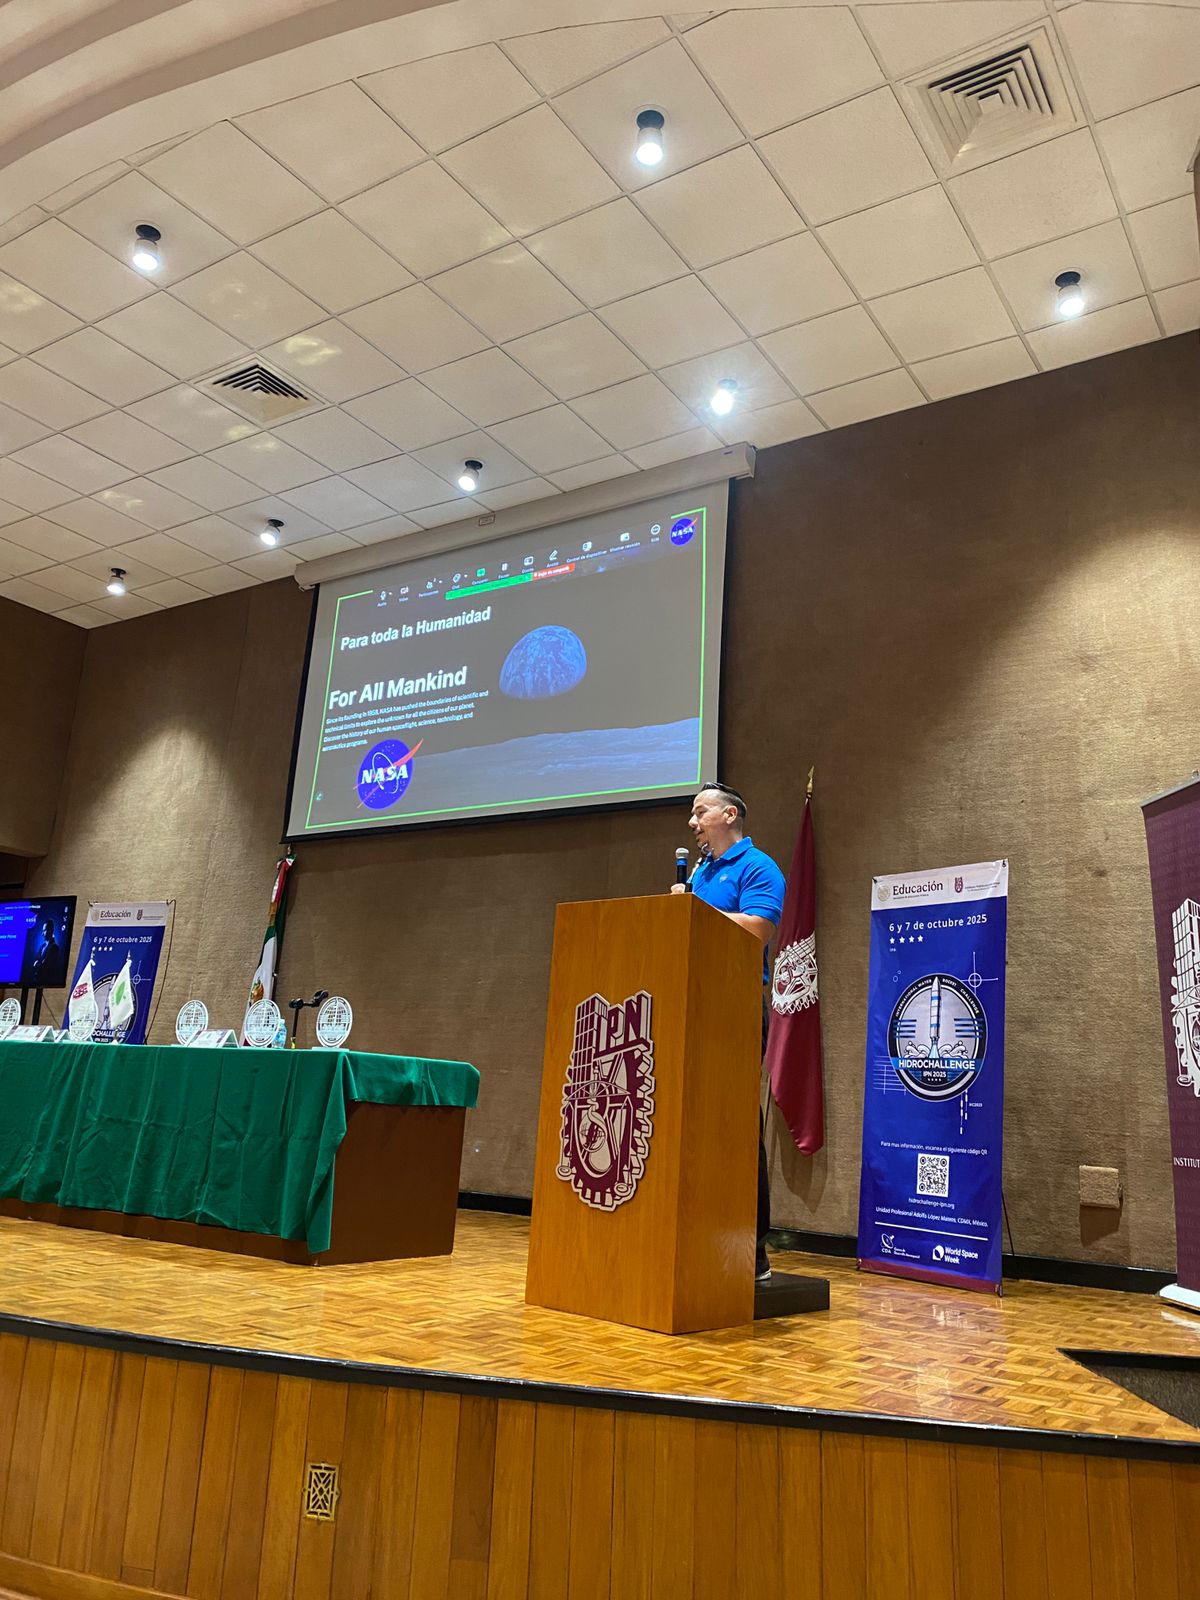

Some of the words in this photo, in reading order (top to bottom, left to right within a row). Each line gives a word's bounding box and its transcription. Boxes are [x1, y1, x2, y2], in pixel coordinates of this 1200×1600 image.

[672, 527, 694, 538] NASA
[340, 636, 368, 650] Para
[371, 628, 399, 644] toda
[402, 624, 413, 638] la
[416, 606, 492, 634] Humanidad
[328, 690, 357, 710] For
[358, 682, 384, 704] All
[386, 666, 468, 698] Mankind
[426, 696, 452, 706] boundaries
[361, 764, 408, 784] NASA
[893, 881, 944, 896] Educación
[100, 910, 131, 918] Educación
[889, 923, 894, 932] 6
[897, 924, 902, 934] y
[906, 922, 910, 930] 7
[914, 920, 924, 930] de
[927, 918, 964, 929] octubre
[966, 914, 988, 925] 2025
[896, 986, 918, 1017] INTERNATIONAL
[918, 978, 932, 988] WATER
[960, 988, 980, 1014] CHALLENGE
[898, 1060, 976, 1070] HIDROCHALLENGE
[944, 1246, 961, 1256] World
[962, 1250, 978, 1259] Space
[944, 1255, 960, 1264] Week
